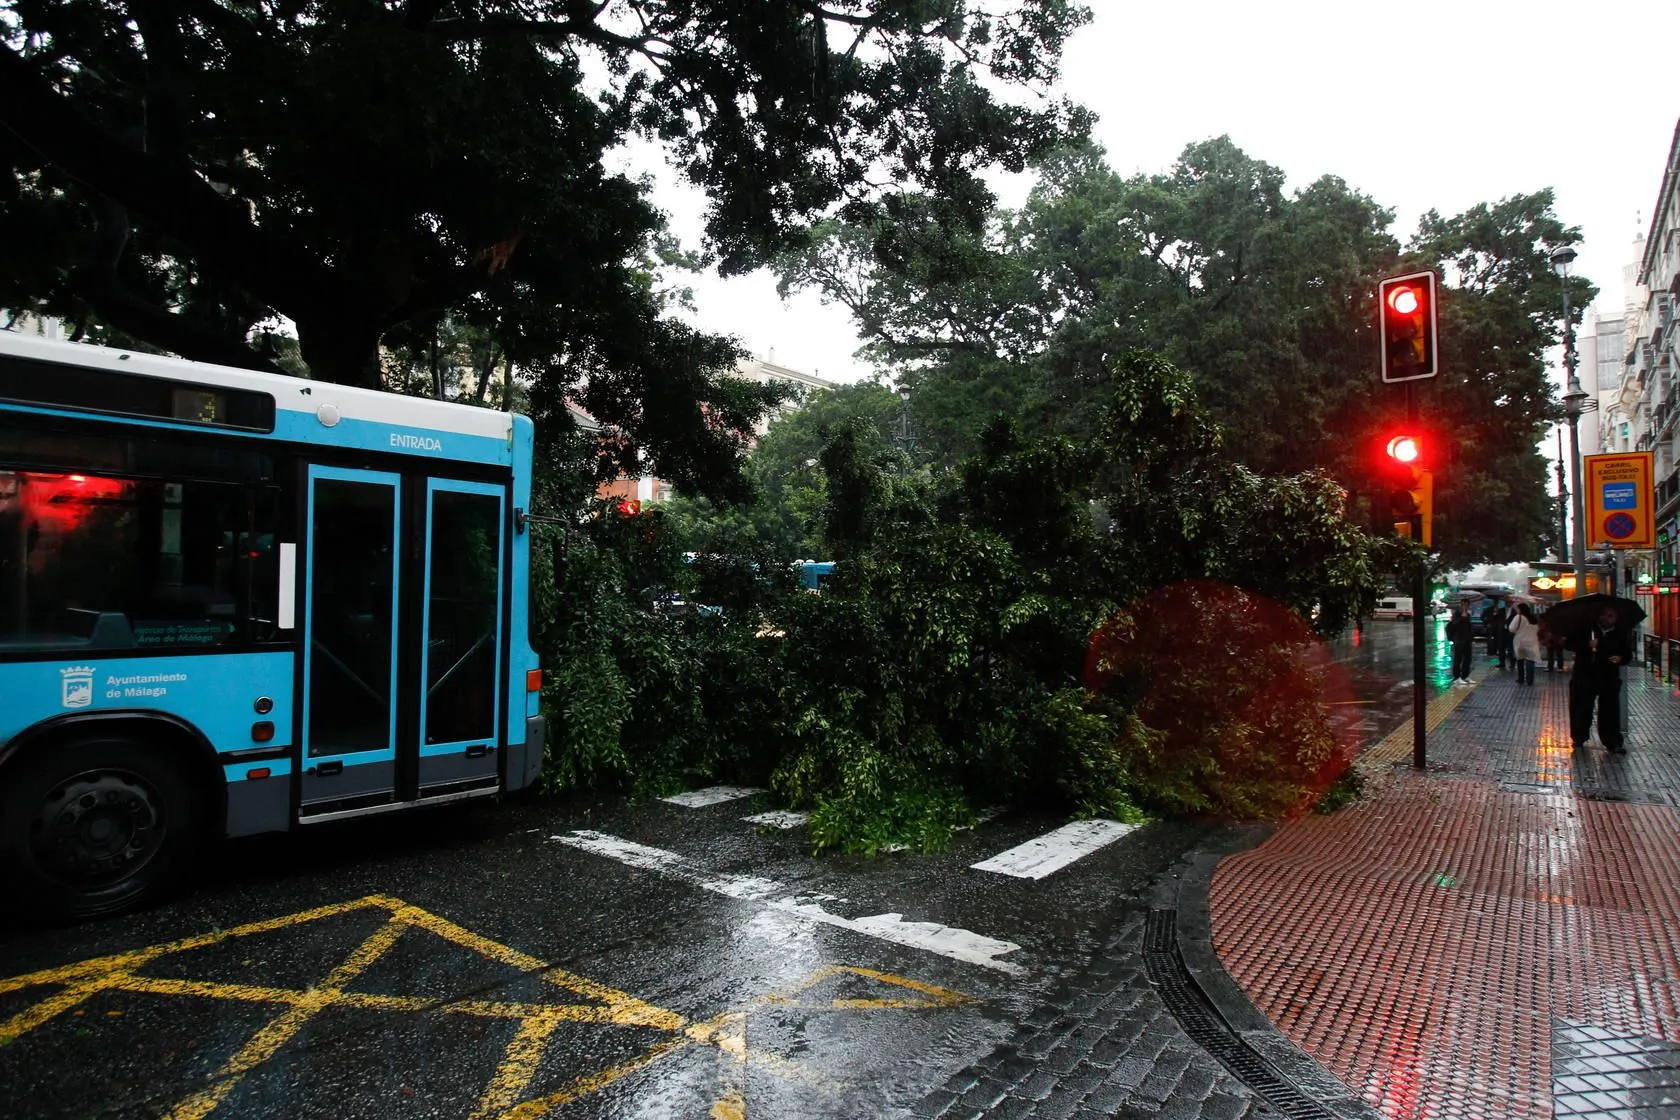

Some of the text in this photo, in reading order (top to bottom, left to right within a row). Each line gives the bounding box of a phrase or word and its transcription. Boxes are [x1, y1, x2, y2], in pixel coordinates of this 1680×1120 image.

[390, 433, 442, 452] ENTRADA
[1598, 467, 1640, 475] EXCLUSIVO
[106, 673, 188, 686] Ayuntamiento
[106, 687, 167, 698] de Málaga
